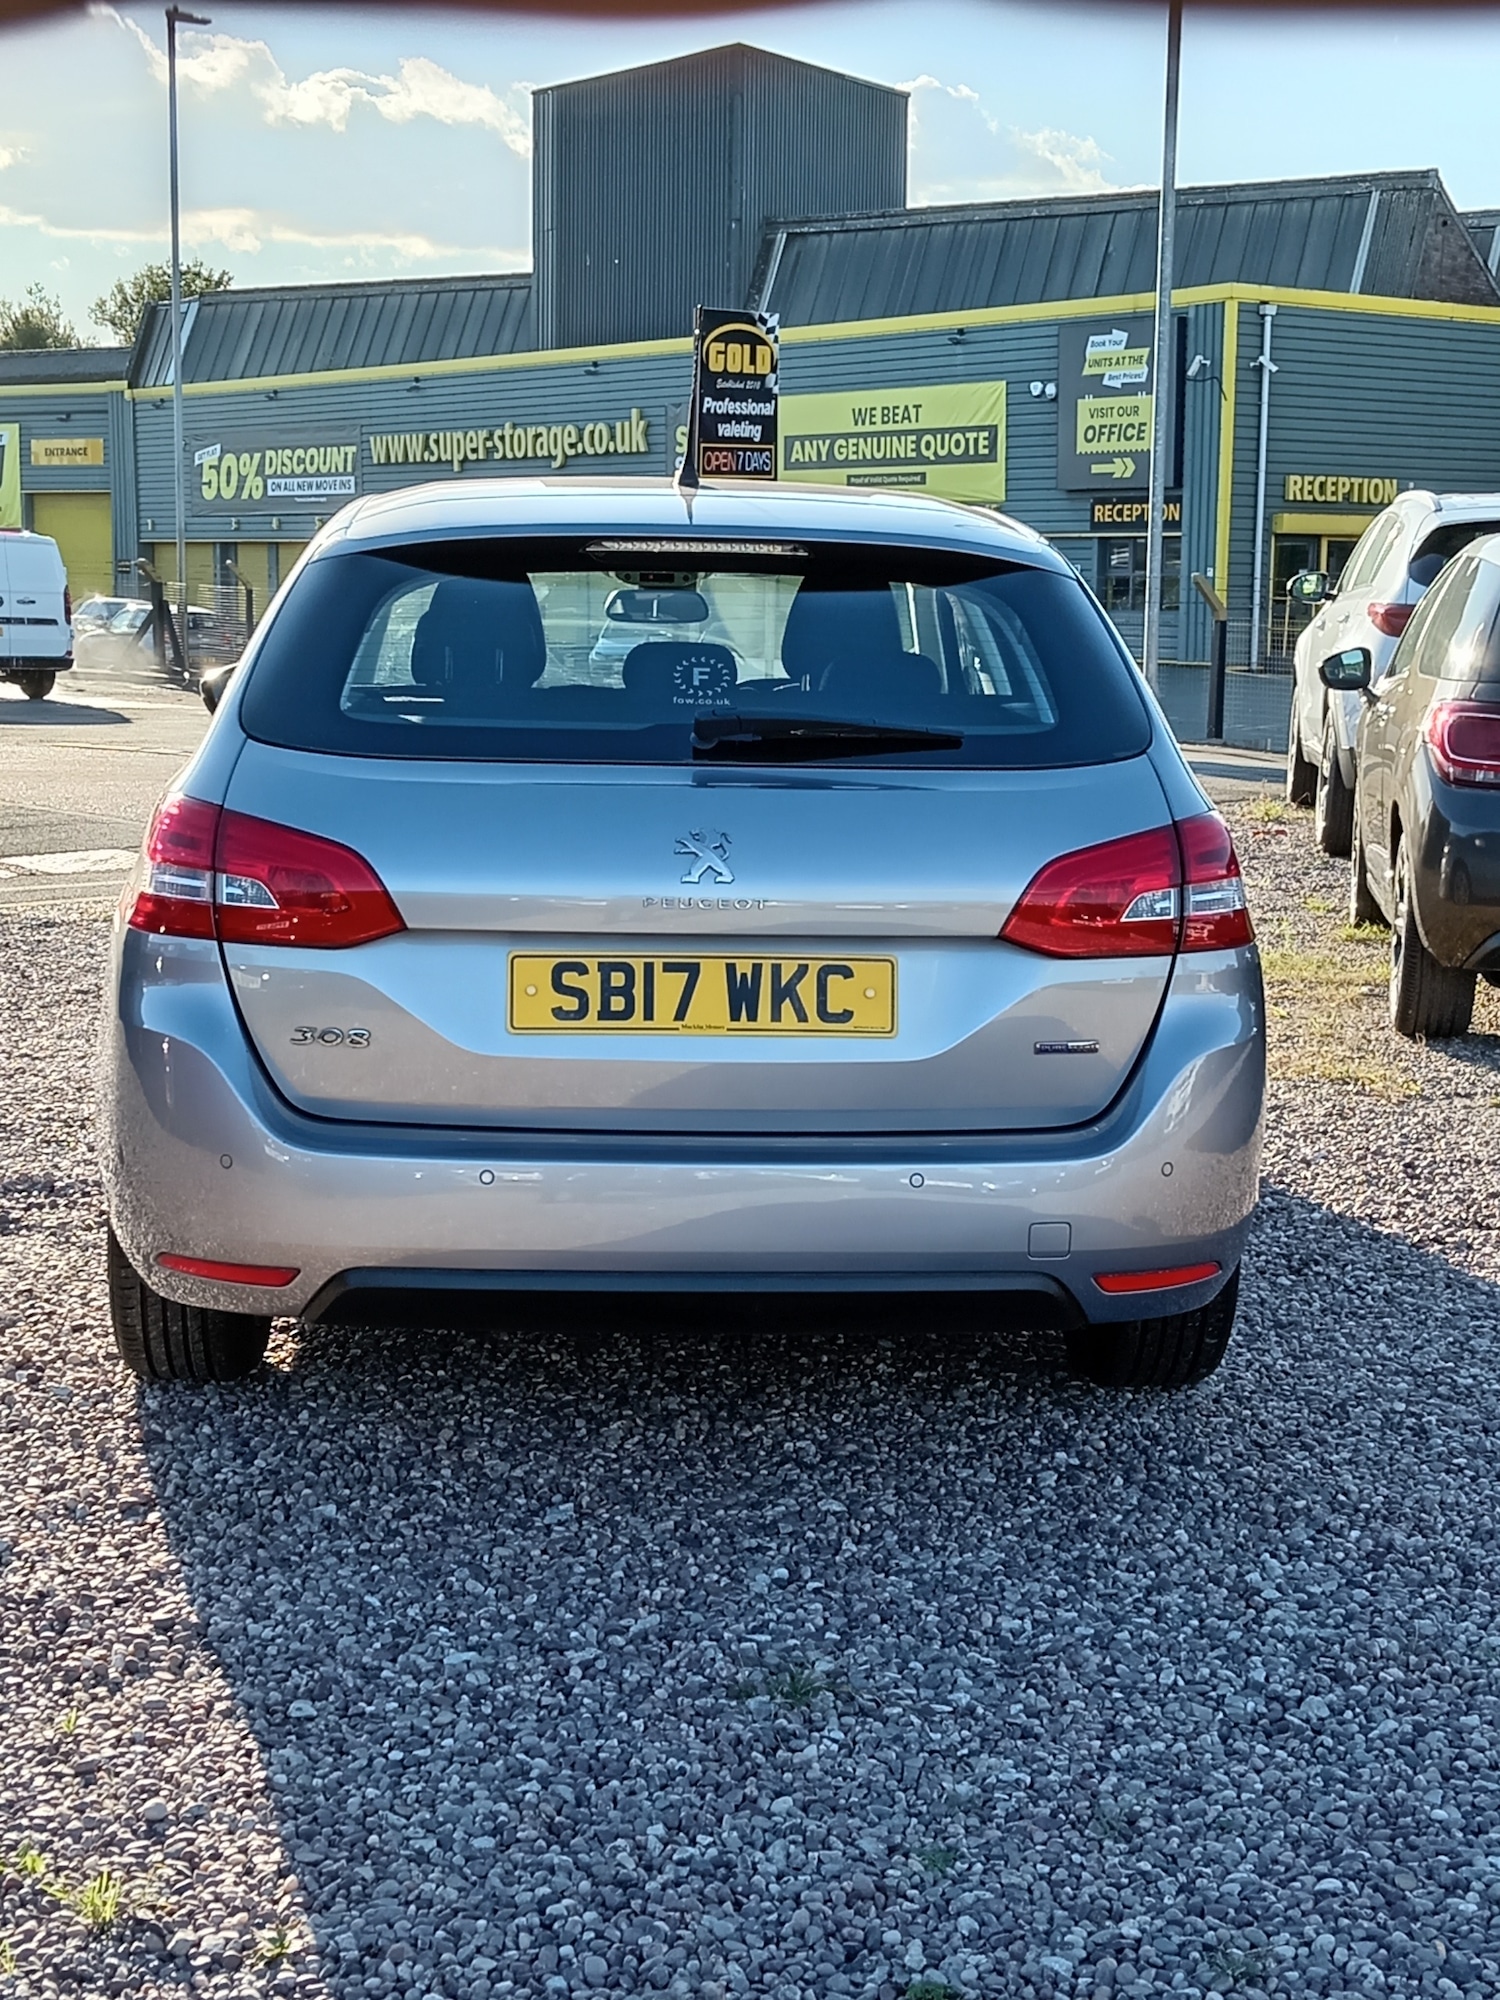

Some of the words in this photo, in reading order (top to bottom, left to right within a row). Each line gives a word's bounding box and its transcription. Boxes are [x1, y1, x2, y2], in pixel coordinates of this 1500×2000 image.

[1089, 338, 1105, 349] Book
[1106, 337, 1125, 347] Your
[708, 341, 772, 375] GOLD
[1088, 356, 1113, 368] UNITS
[1114, 355, 1127, 367] AT
[1128, 353, 1145, 366] THE
[1108, 371, 1121, 382] Best
[1121, 370, 1145, 381] Prices!
[702, 396, 775, 416] Professional
[852, 406, 877, 426] WE
[881, 404, 923, 425] BEAT
[1088, 406, 1115, 419] VISIT
[1117, 405, 1140, 418] OUR
[369, 408, 649, 472] www.super-storage.co.uk
[717, 420, 763, 443] valeting
[1083, 422, 1148, 444] OFFICE
[44, 447, 88, 457] ENTRANCE
[790, 439, 831, 463] ANY
[833, 434, 917, 461] GENUINE
[920, 430, 990, 461] QUOTE
[704, 451, 736, 472] OPEN
[737, 451, 744, 471] 7
[745, 451, 772, 472] DAYS
[201, 452, 264, 501] 50%
[264, 445, 357, 475] DISCOUNT
[271, 481, 282, 492] ON
[283, 481, 296, 492] ALL
[297, 480, 315, 492] NEW
[315, 479, 338, 491] MOVE
[338, 479, 352, 490] INS
[1286, 475, 1397, 504] RECEPTION
[1094, 502, 1180, 522] RECEPTN
[692, 667, 711, 686] F
[672, 696, 731, 706] fow.co.uk
[642, 897, 766, 911] PEUGEOT
[550, 961, 702, 1022] SB17
[725, 962, 855, 1024] WKC
[289, 1026, 372, 1049] 308
